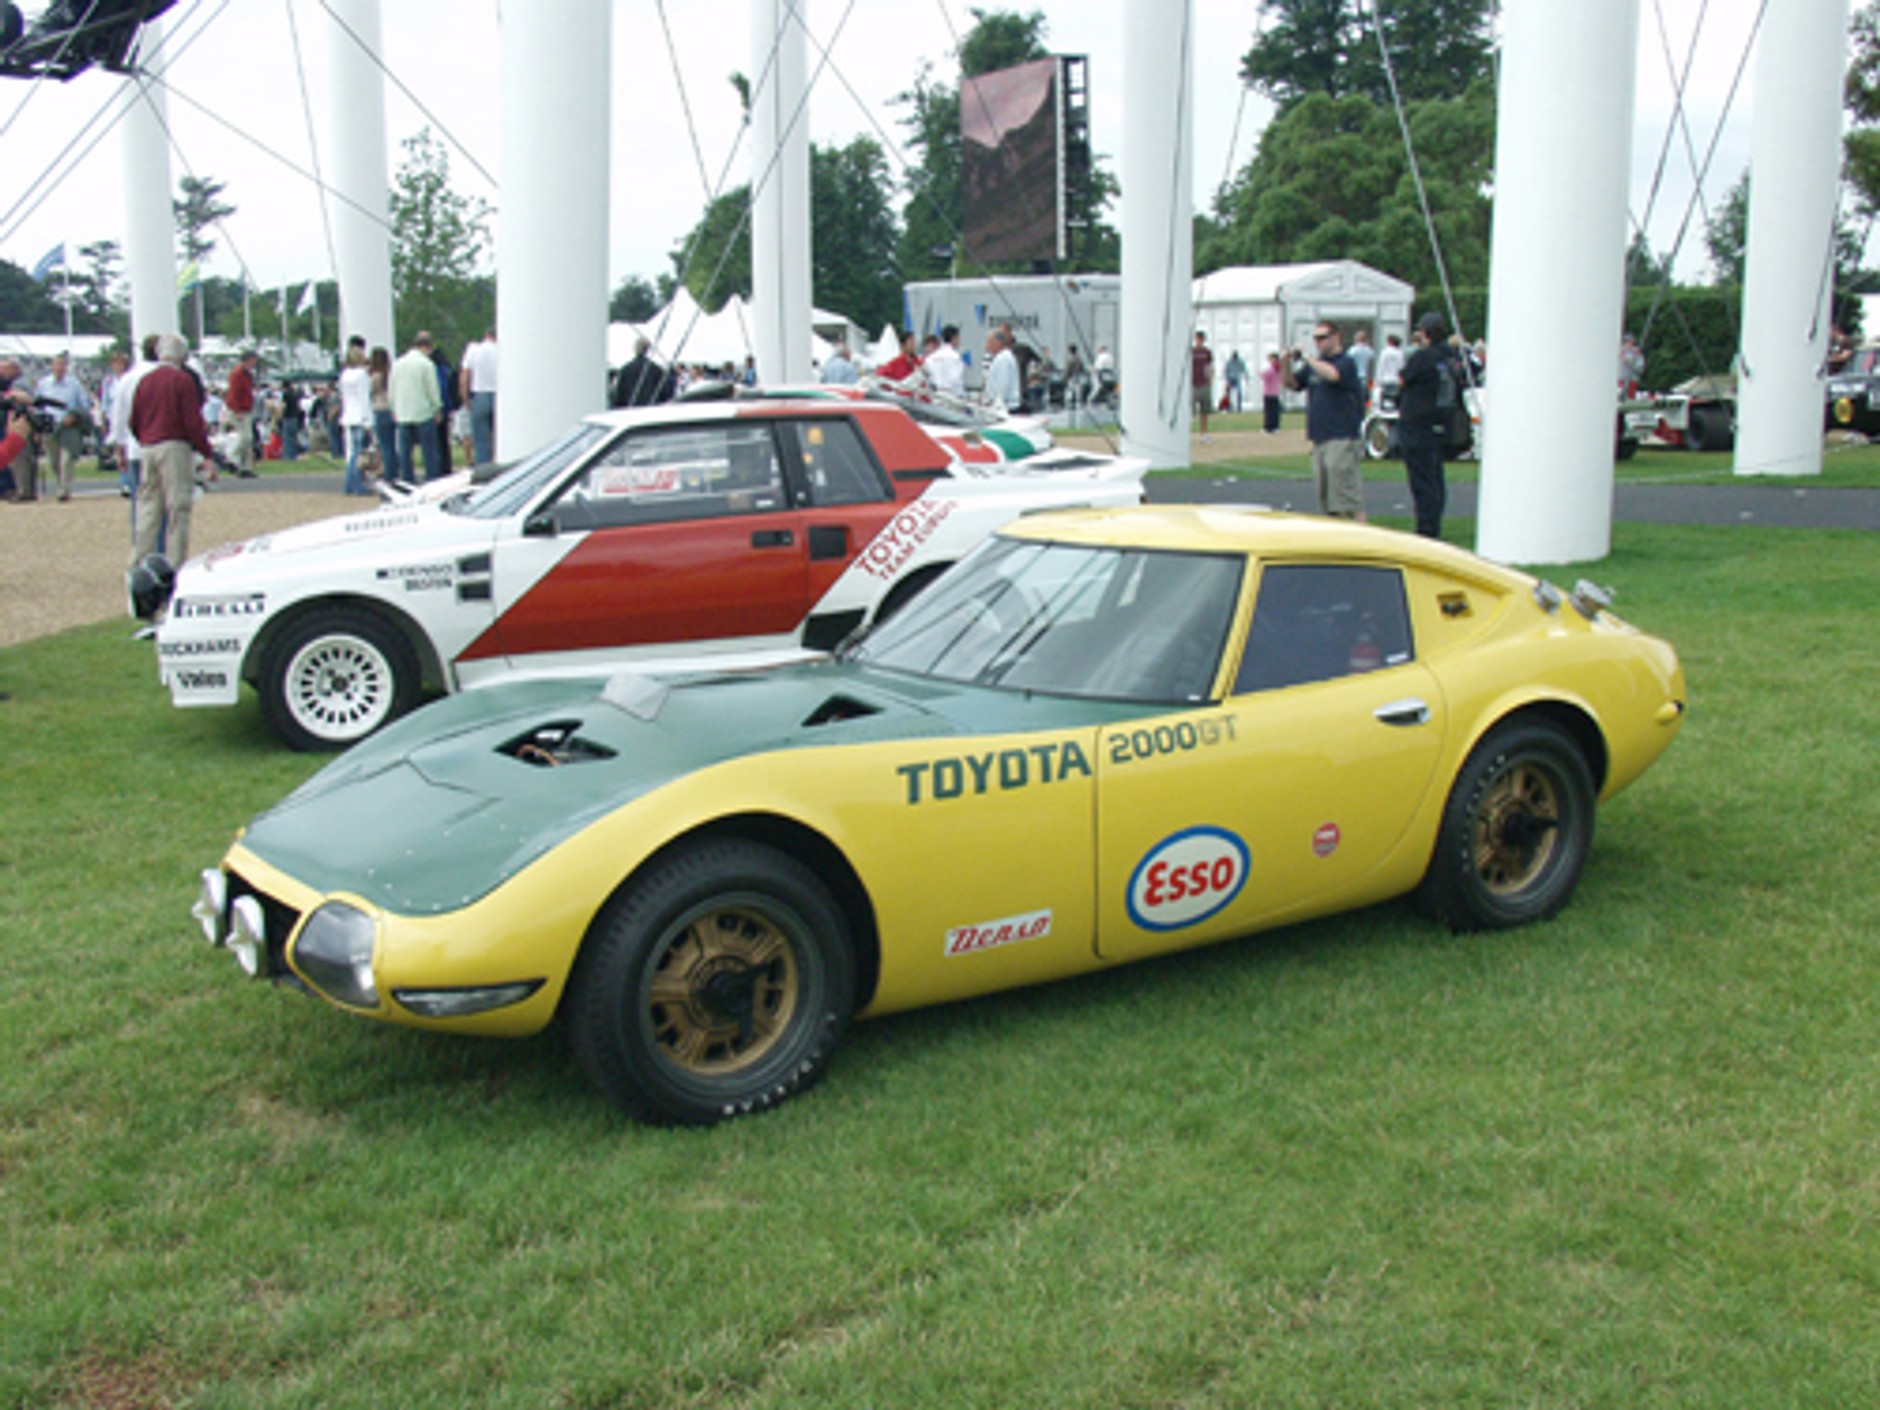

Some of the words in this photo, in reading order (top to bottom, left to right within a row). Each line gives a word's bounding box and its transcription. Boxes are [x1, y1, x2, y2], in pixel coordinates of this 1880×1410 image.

[855, 500, 937, 576] TOYOTA
[896, 740, 1092, 805] TOYOTA
[1142, 855, 1236, 908] Esso
